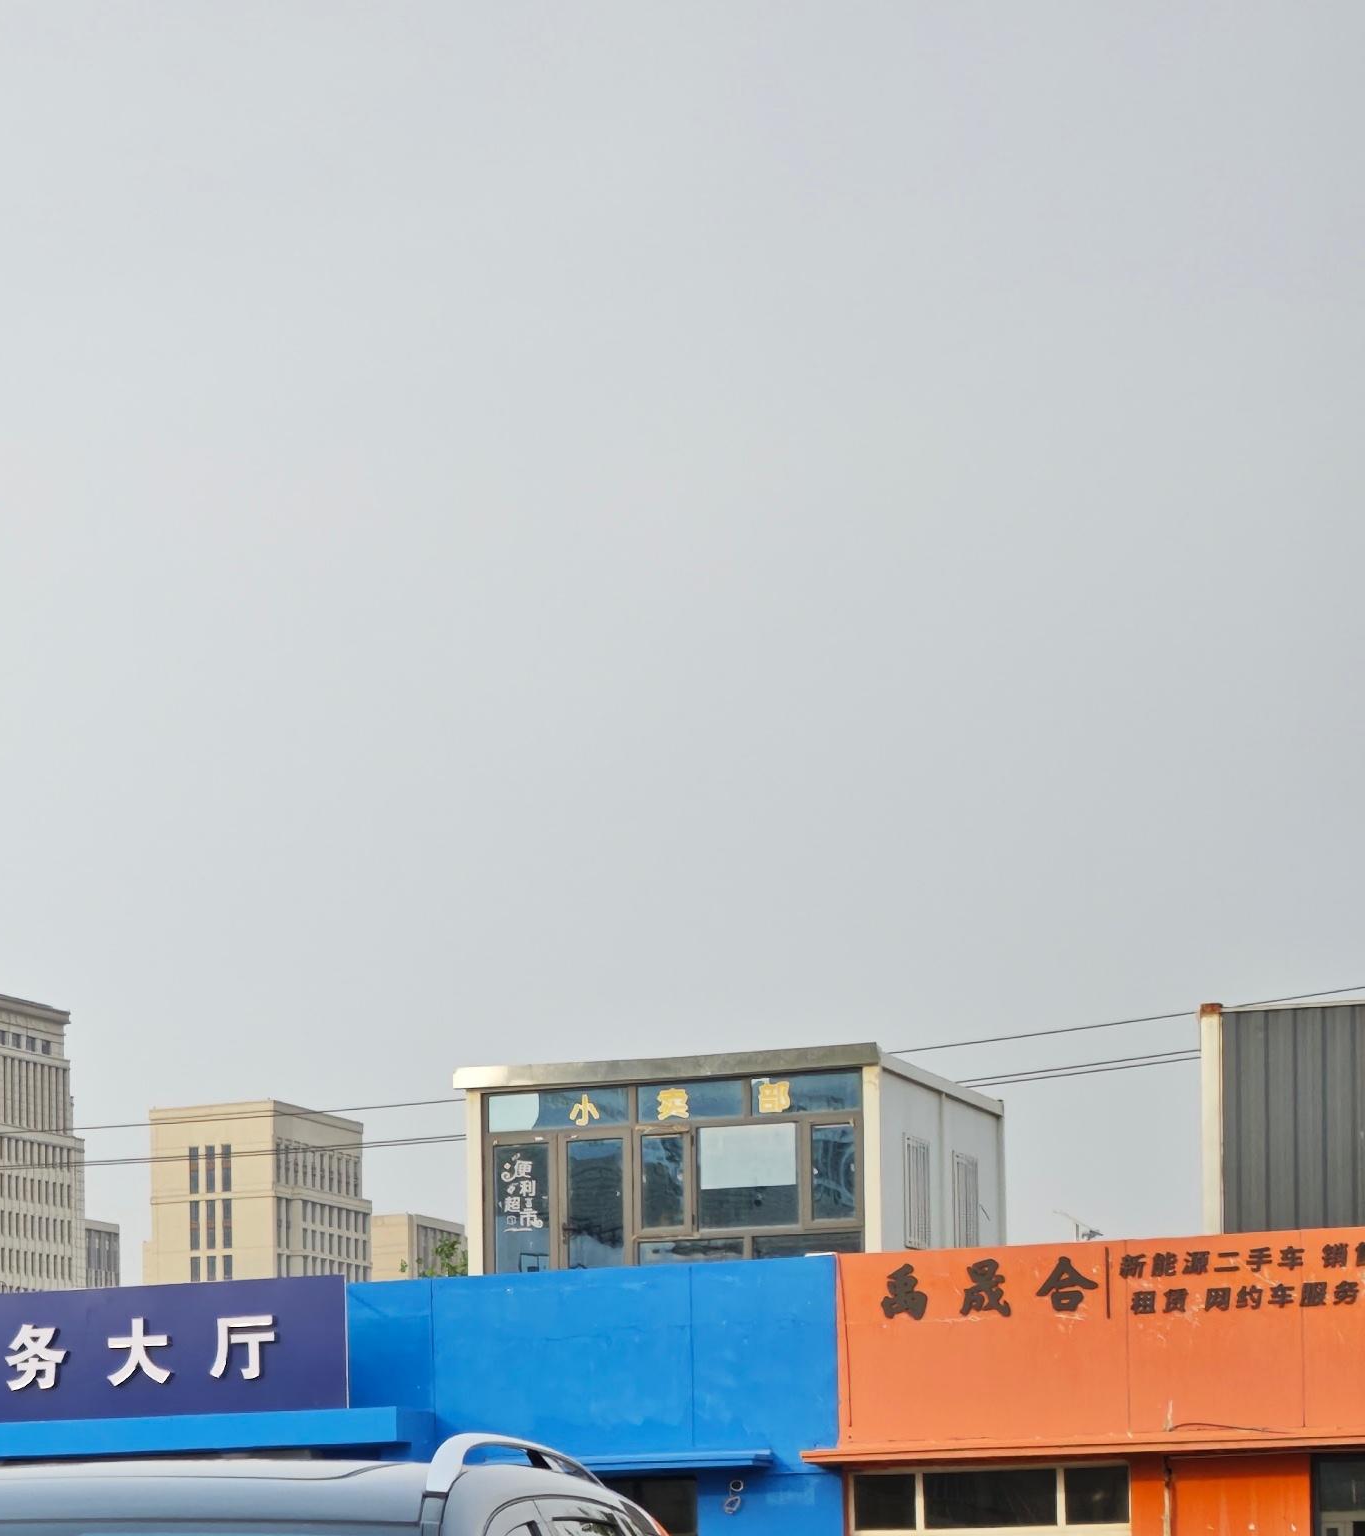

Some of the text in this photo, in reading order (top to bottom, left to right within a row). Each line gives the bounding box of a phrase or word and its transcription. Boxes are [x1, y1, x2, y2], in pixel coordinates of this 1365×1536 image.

[569, 1080, 791, 1126] 小卖部
[1119, 1245, 1305, 1279] 新能源二手车
[1130, 1280, 1360, 1315] 租赁 网约车服务
